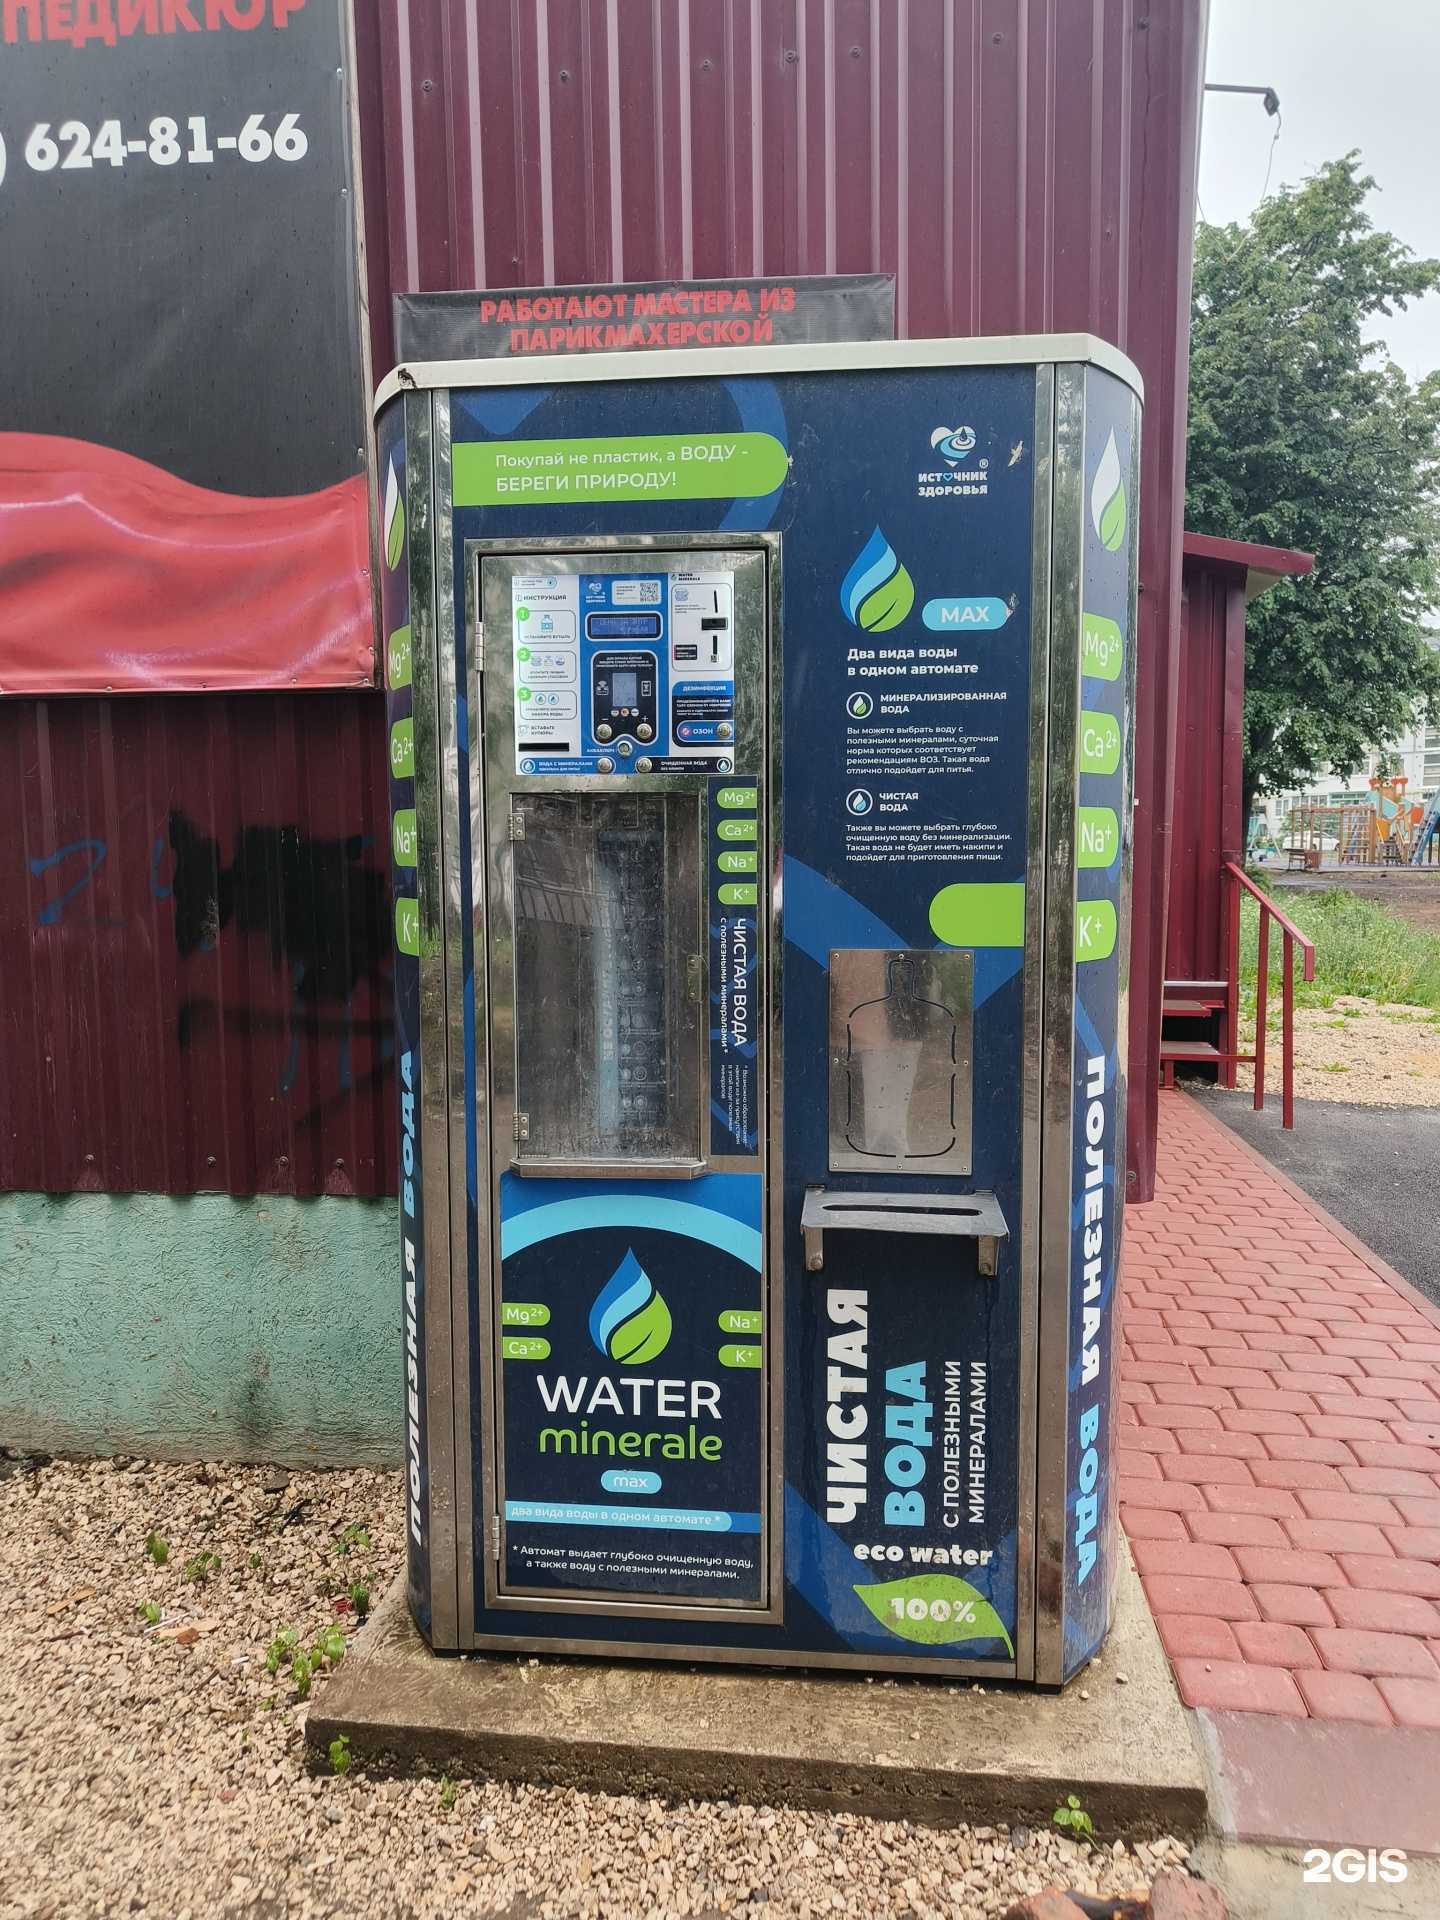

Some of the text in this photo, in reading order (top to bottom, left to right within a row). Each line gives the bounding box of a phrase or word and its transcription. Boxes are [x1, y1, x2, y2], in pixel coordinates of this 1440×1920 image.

[25, 113, 308, 171] 624-81-66
[481, 287, 796, 323] РАБОТАЮТ МАСТЕРА ИЗ
[511, 313, 773, 352] ПАРИКМАХЕРСКОЙ
[496, 453, 564, 469] Покупай
[569, 453, 588, 465] не
[593, 450, 663, 465] пластик,
[666, 450, 675, 462] а
[681, 444, 737, 464] ВОДУ
[496, 472, 677, 492] БЕРЕГИ ПРИРОДУ!
[918, 485, 988, 498] ЗДОРОВЬЯ
[940, 606, 990, 623] MAX
[847, 647, 957, 661] Два вида воды
[847, 663, 978, 677] в одном автомате
[880, 692, 1007, 702] МИНЕРАЛИЗИРОВАННАЯ
[880, 705, 910, 714] ВОДА
[847, 727, 860, 735] Вы
[862, 727, 894, 735] можете
[896, 726, 933, 735] выбрать
[935, 726, 957, 734] воду
[847, 735, 999, 745] полезными минералами, суточная
[847, 745, 977, 756] норма которых соответствует
[846, 757, 918, 766] рекомендациям
[942, 755, 967, 763] Такая
[969, 755, 990, 763] вода
[884, 766, 926, 775] подойдет
[879, 792, 919, 801] ЧИСТАЯ
[879, 803, 909, 812] ВОДА
[846, 824, 873, 832] Также
[923, 823, 961, 832] выбрать
[962, 823, 998, 832] глубоко
[1081, 821, 1112, 852] Na+
[846, 833, 1013, 842] очищенную воду без минерализации.
[907, 843, 932, 852] будет
[962, 843, 996, 851] накипи
[846, 853, 888, 862] подойдет
[907, 853, 974, 862] приготовления
[976, 853, 1003, 861] пищи.
[1079, 913, 1103, 948] K+
[719, 925, 728, 983] полезными
[731, 917, 747, 1047] ЧИСТАЯ ВОДА
[401, 1050, 422, 1547] ПОЛЕЗНАЯ ВОДА
[729, 1315, 759, 1329] Na+
[1075, 1055, 1106, 1587] ПОЛЕЗНАЯ ВОДА
[736, 1349, 752, 1363] K+
[536, 1374, 722, 1420] WATER
[826, 1288, 868, 1524] ЧИСТАЯ
[539, 1420, 723, 1461] minerale
[884, 1360, 934, 1526] ВОДА
[943, 1360, 961, 1529] С ПОЛЕЗНЫМИ
[968, 1361, 987, 1524] МИНЕРАЛАМИ
[613, 1475, 648, 1488] max
[511, 1507, 532, 1517] два
[535, 1508, 564, 1519] вида
[566, 1510, 598, 1520] воды
[611, 1512, 650, 1523] одном
[654, 1513, 713, 1525] автомате
[520, 1546, 754, 1569] Автомат выдает глубоко очищенную воду,
[853, 1542, 993, 1566] eco water
[534, 1560, 567, 1569] также
[569, 1562, 596, 1573] воду
[606, 1563, 667, 1575] полезными
[669, 1567, 740, 1580] минералами.
[891, 1597, 977, 1624] 100%
